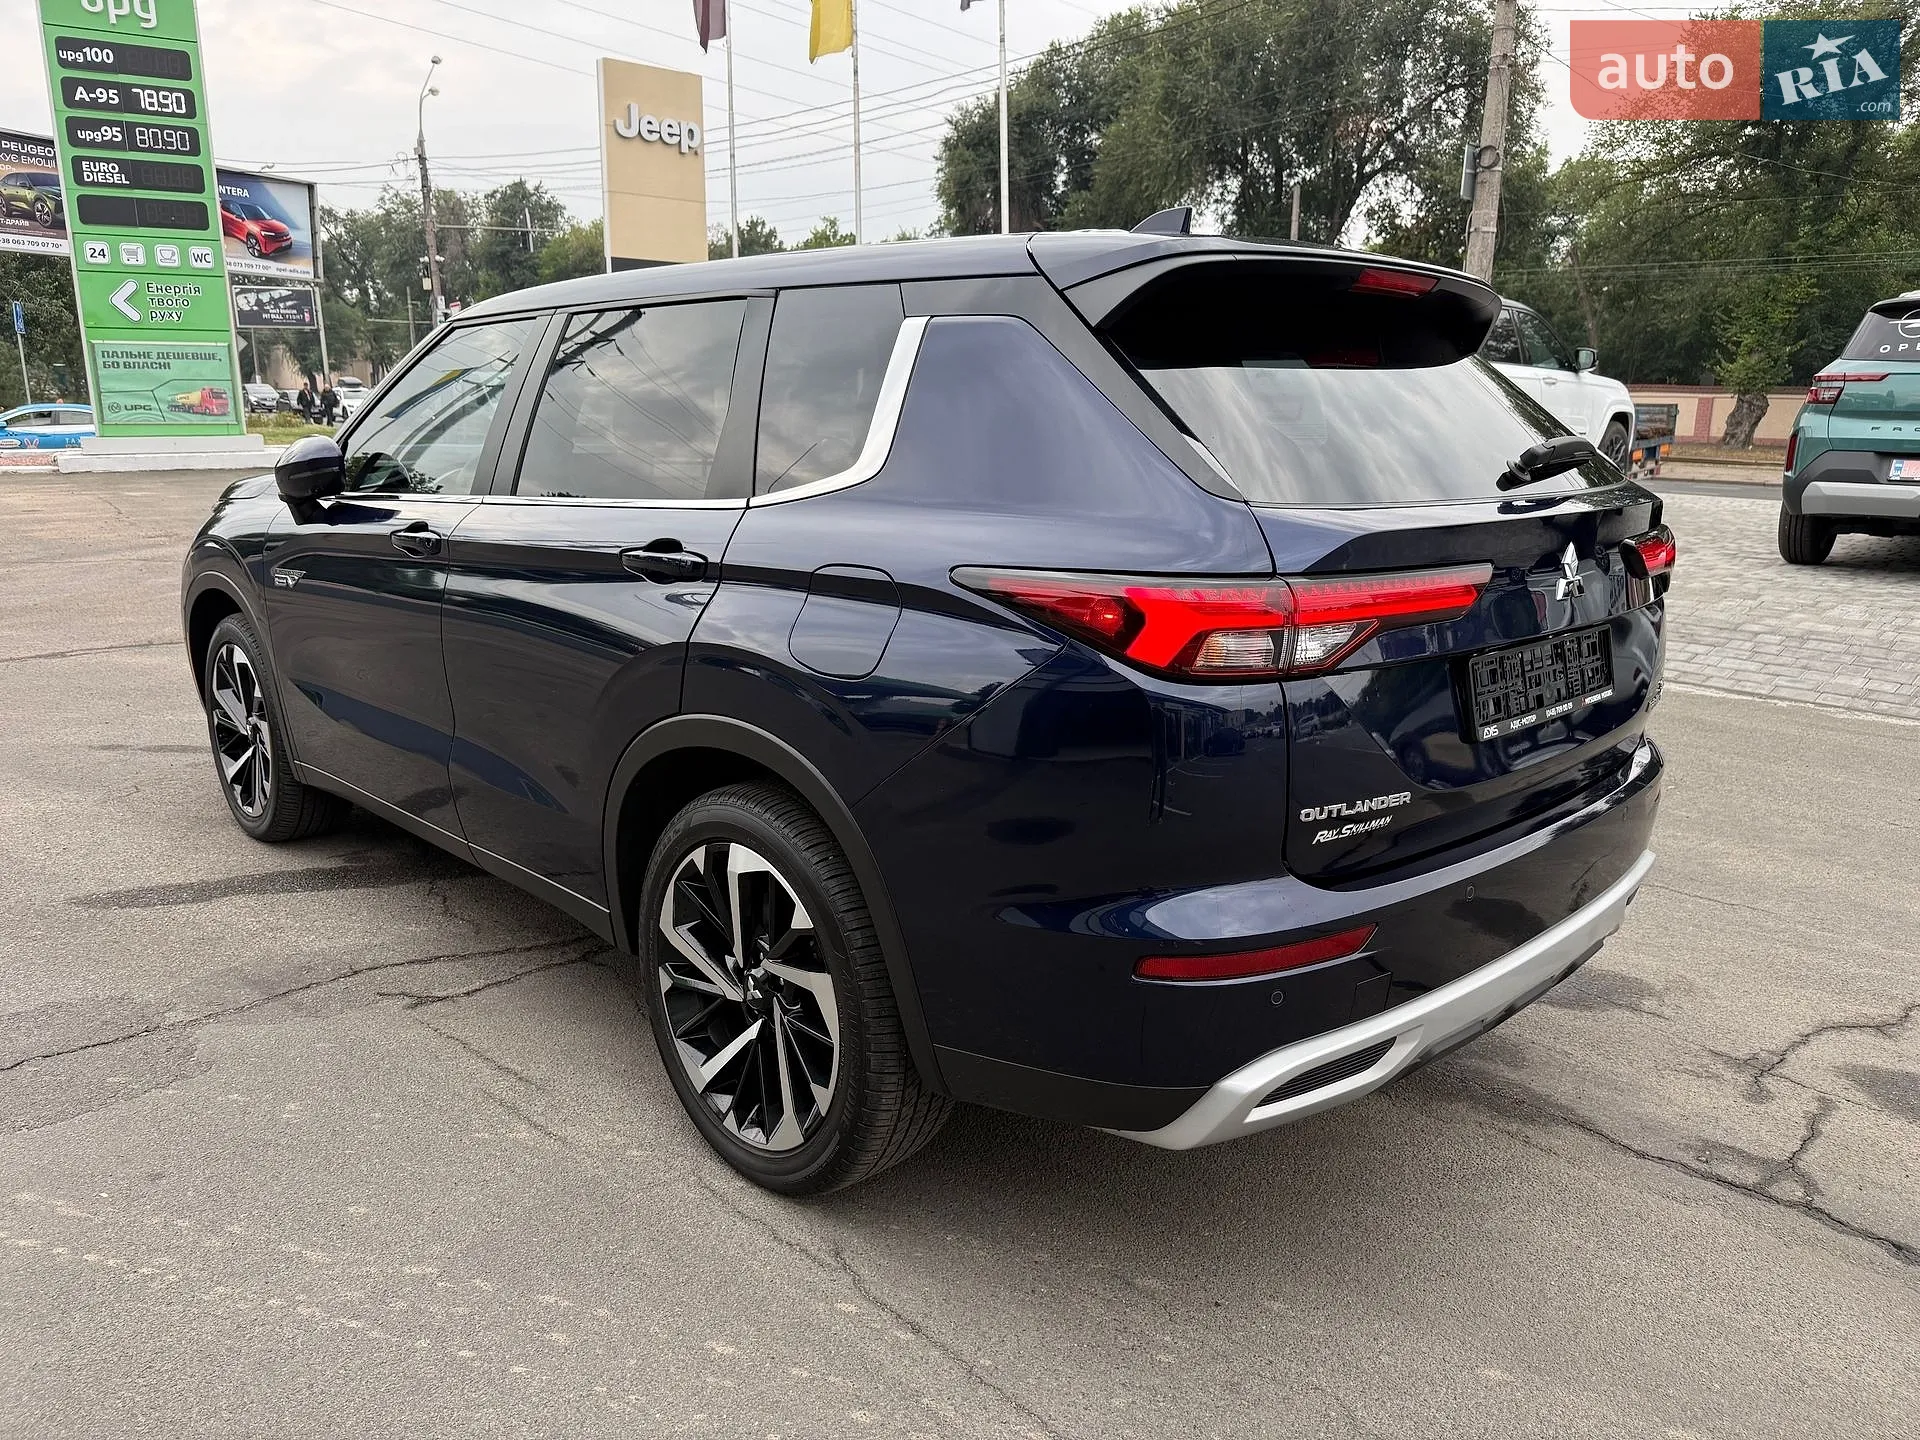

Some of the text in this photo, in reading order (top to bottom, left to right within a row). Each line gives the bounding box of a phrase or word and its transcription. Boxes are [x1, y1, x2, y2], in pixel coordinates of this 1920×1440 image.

[74, 86, 120, 104] A-95
[131, 88, 187, 114] 78.90
[615, 103, 701, 154] Jeep
[135, 127, 190, 151] 80.90
[1, 140, 57, 157] PEUGEO
[81, 161, 119, 173] EURO
[83, 172, 131, 185] DIESEL
[218, 184, 250, 198] NTERA
[88, 247, 107, 259] 24
[192, 252, 212, 264] WC
[146, 282, 201, 296] Енергія
[148, 297, 190, 307] твого
[149, 310, 183, 322] руху
[101, 350, 153, 360] ПАЛЬНЕ
[103, 361, 171, 370] БО ВЛАСНІ
[1299, 791, 1412, 823] OUTLANDER
